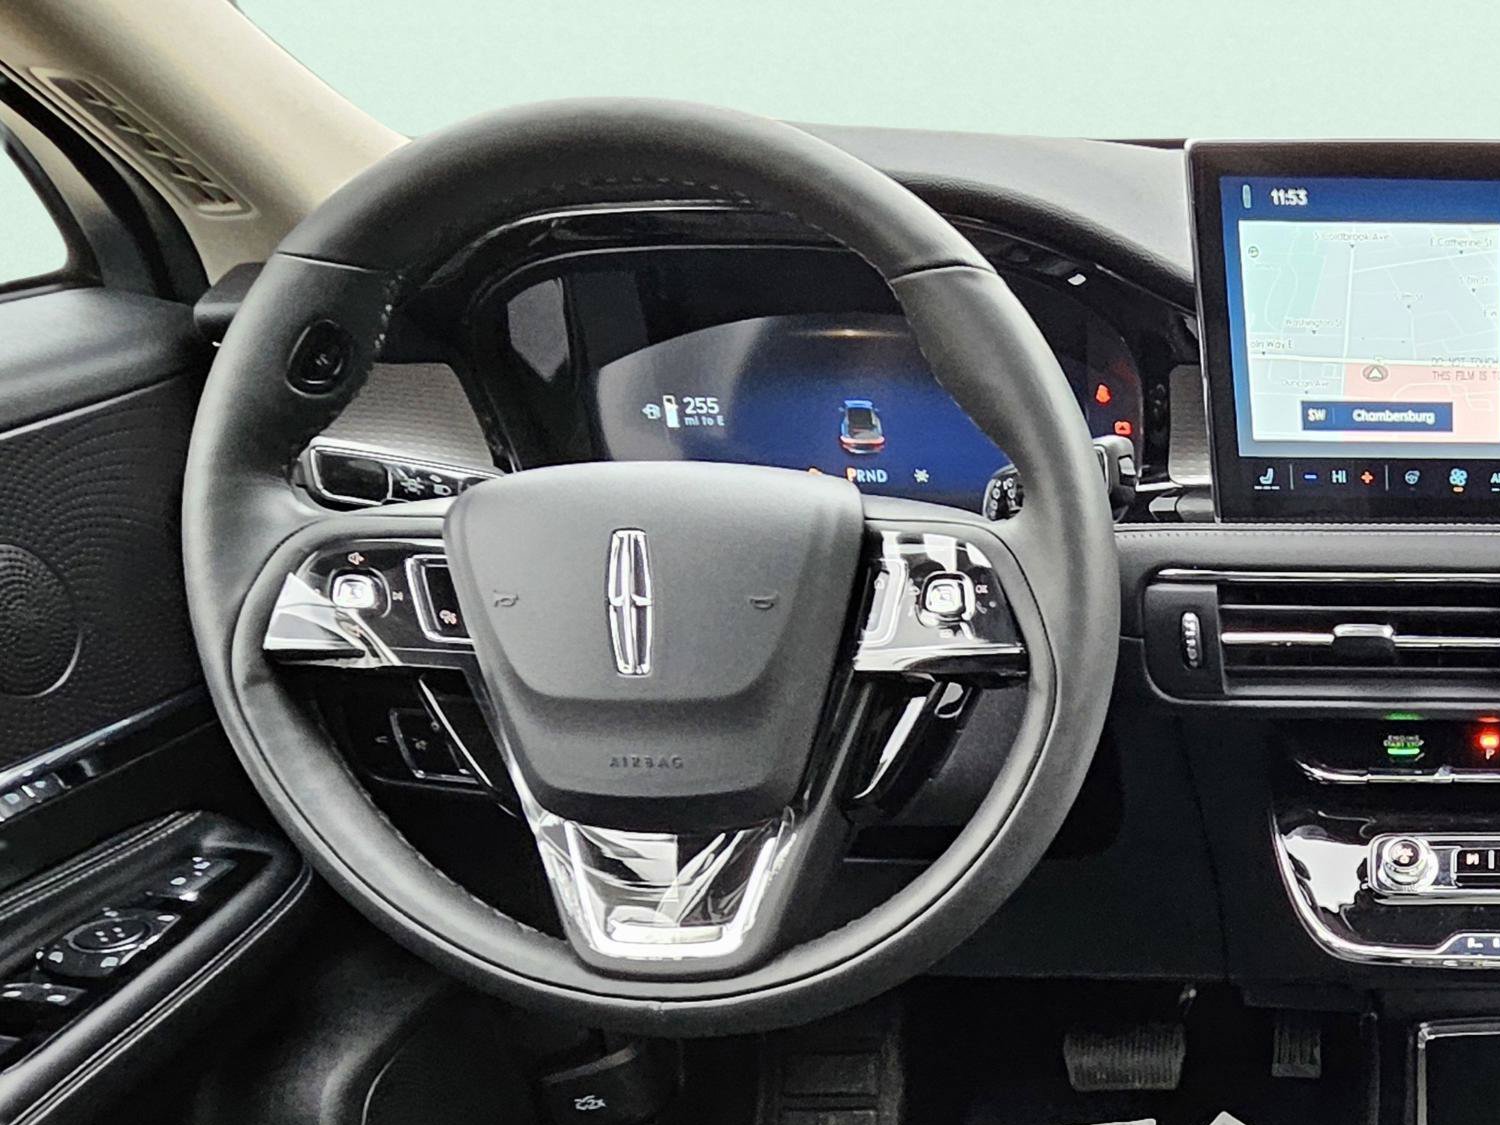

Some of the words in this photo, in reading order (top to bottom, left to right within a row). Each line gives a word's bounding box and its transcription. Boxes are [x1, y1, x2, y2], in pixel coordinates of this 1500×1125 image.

[1271, 188, 1308, 206] 11:53
[1432, 371, 1451, 381] THIS
[1455, 371, 1475, 381] FILM
[1480, 371, 1488, 380] IS
[683, 396, 720, 414] 255
[702, 416, 714, 426] to
[717, 415, 725, 426] E
[1308, 409, 1327, 421] SW
[1332, 470, 1347, 484] HI
[609, 756, 685, 770] AIRBAG
